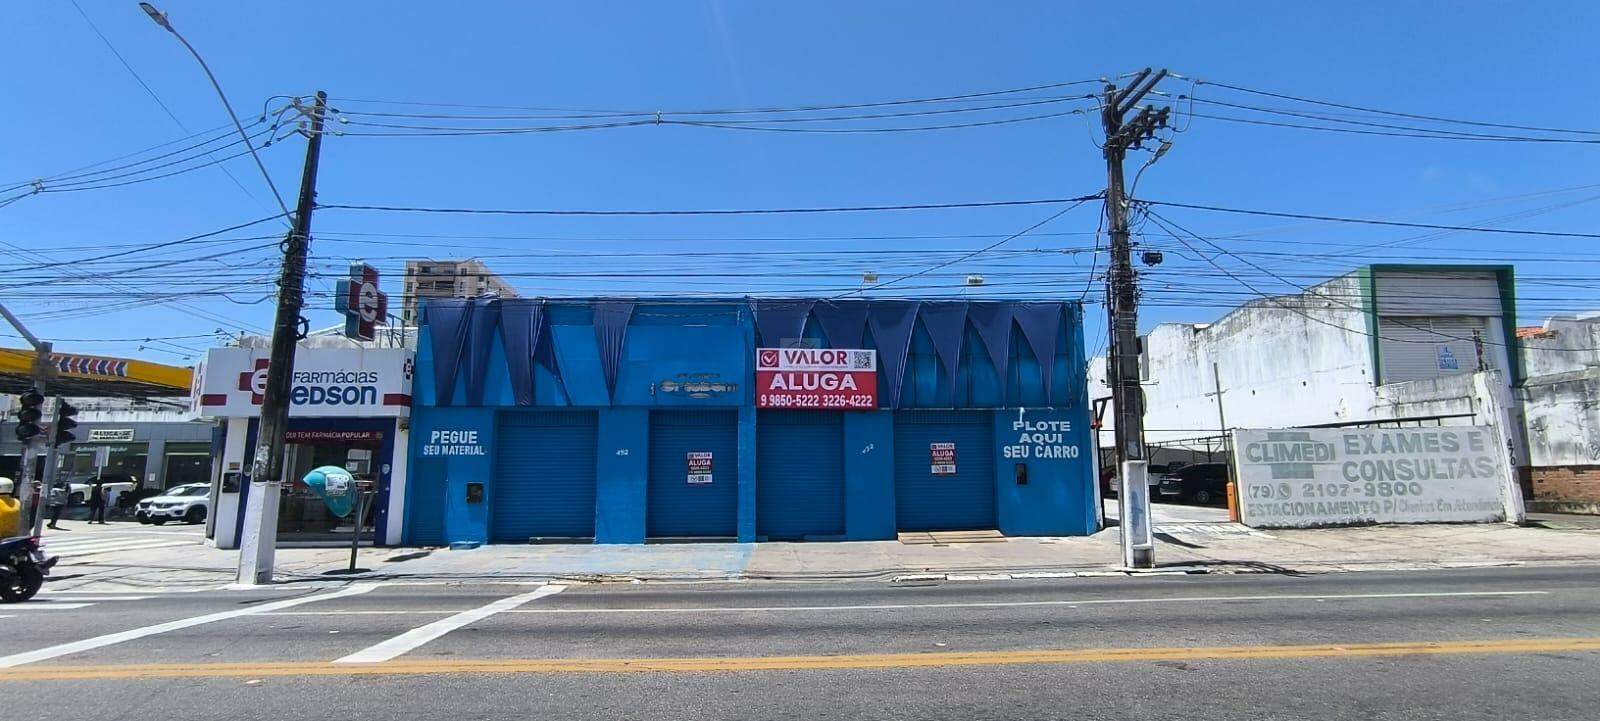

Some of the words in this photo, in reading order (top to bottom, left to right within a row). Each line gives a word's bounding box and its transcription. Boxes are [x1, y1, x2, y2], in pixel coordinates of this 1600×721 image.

[784, 350, 848, 365] VALOR
[769, 373, 857, 391] ALUGA
[761, 394, 767, 407] 9
[769, 394, 819, 407] 9850-5222
[823, 394, 873, 407] 3226-4222
[1013, 421, 1071, 432] PLOTE
[341, 431, 370, 439] POPULAR
[430, 431, 478, 444] PEGUE
[1019, 433, 1062, 446] AQUI
[423, 445, 440, 456] SEU
[441, 445, 486, 456] MATERIAL
[1343, 432, 1460, 456] EXAMES
[1468, 431, 1485, 452] E
[1003, 445, 1029, 458] SEU
[1035, 445, 1079, 458] CARRO
[1245, 442, 1337, 462] CLIMEDI
[1342, 456, 1496, 483] CONSULTAS
[1248, 483, 1275, 499] (79)
[1302, 482, 1423, 498] 2107-9800
[1248, 500, 1381, 517] ESTACIONAMENTO
